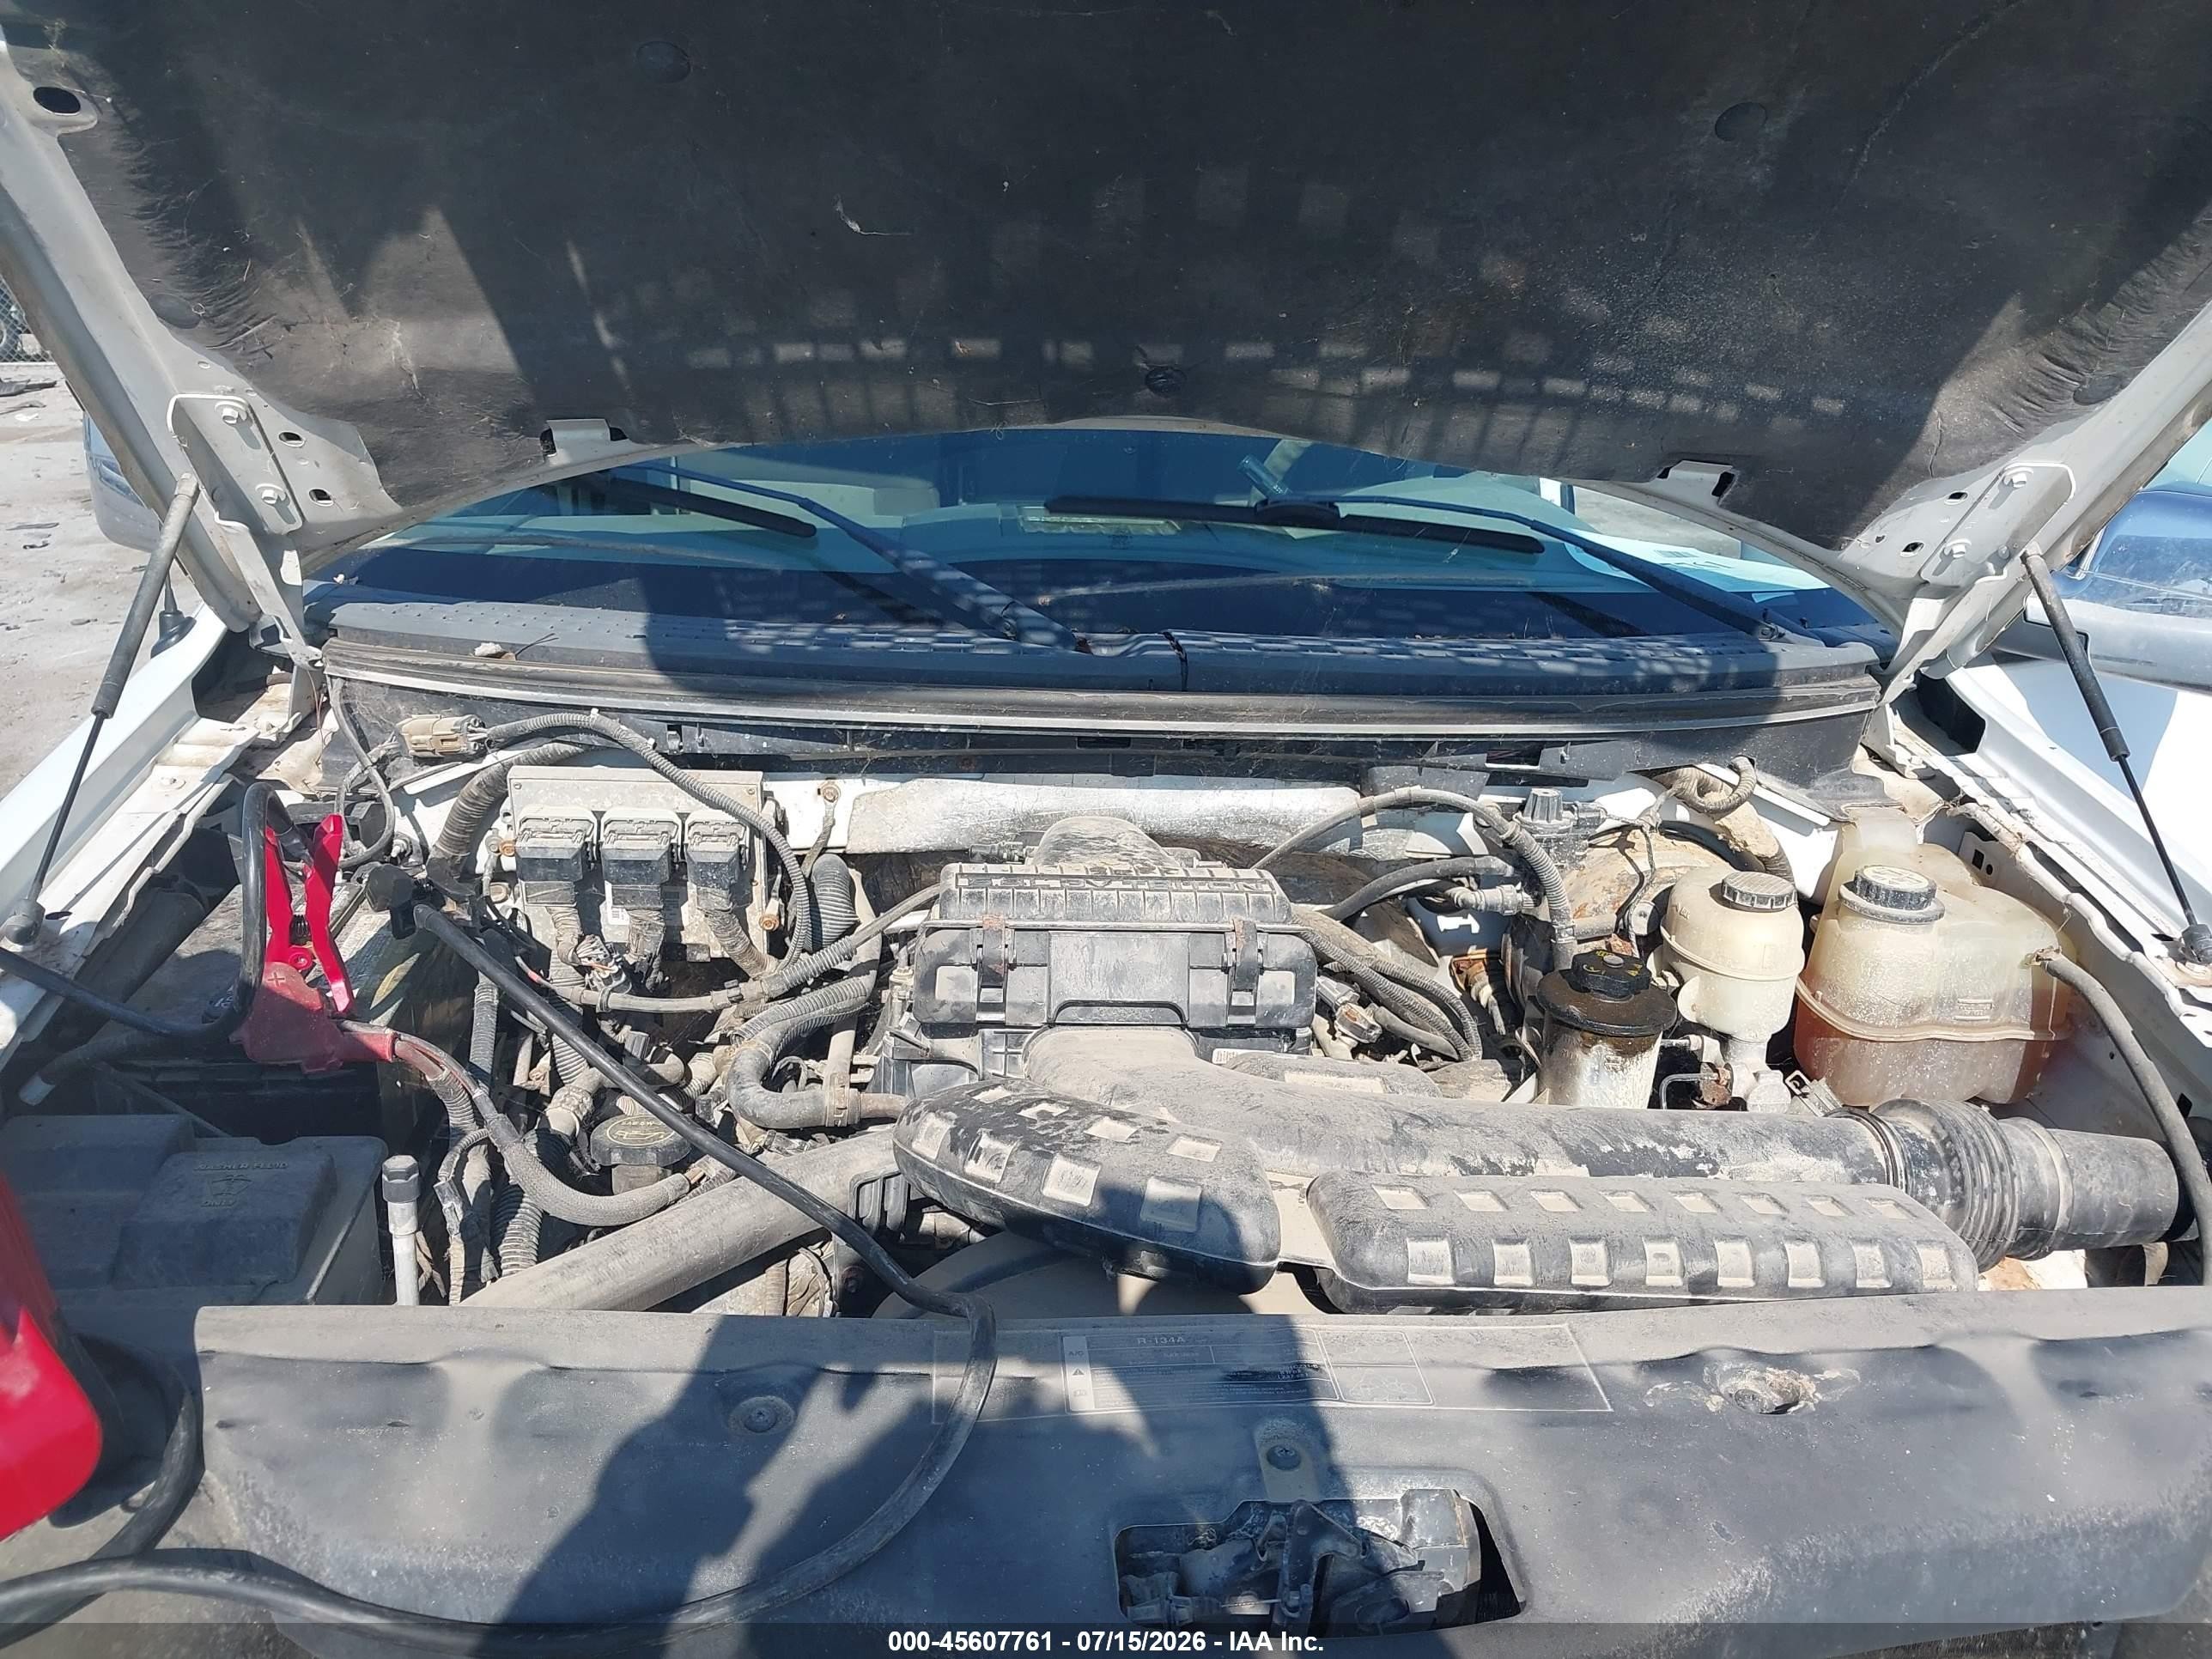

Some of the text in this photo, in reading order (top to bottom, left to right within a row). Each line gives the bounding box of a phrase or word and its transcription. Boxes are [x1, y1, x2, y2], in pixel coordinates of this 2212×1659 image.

[1121, 878, 1267, 891] TRITON
[193, 1160, 289, 1170] WASHER FLUID
[1136, 1335, 1187, 1346] R-134A
